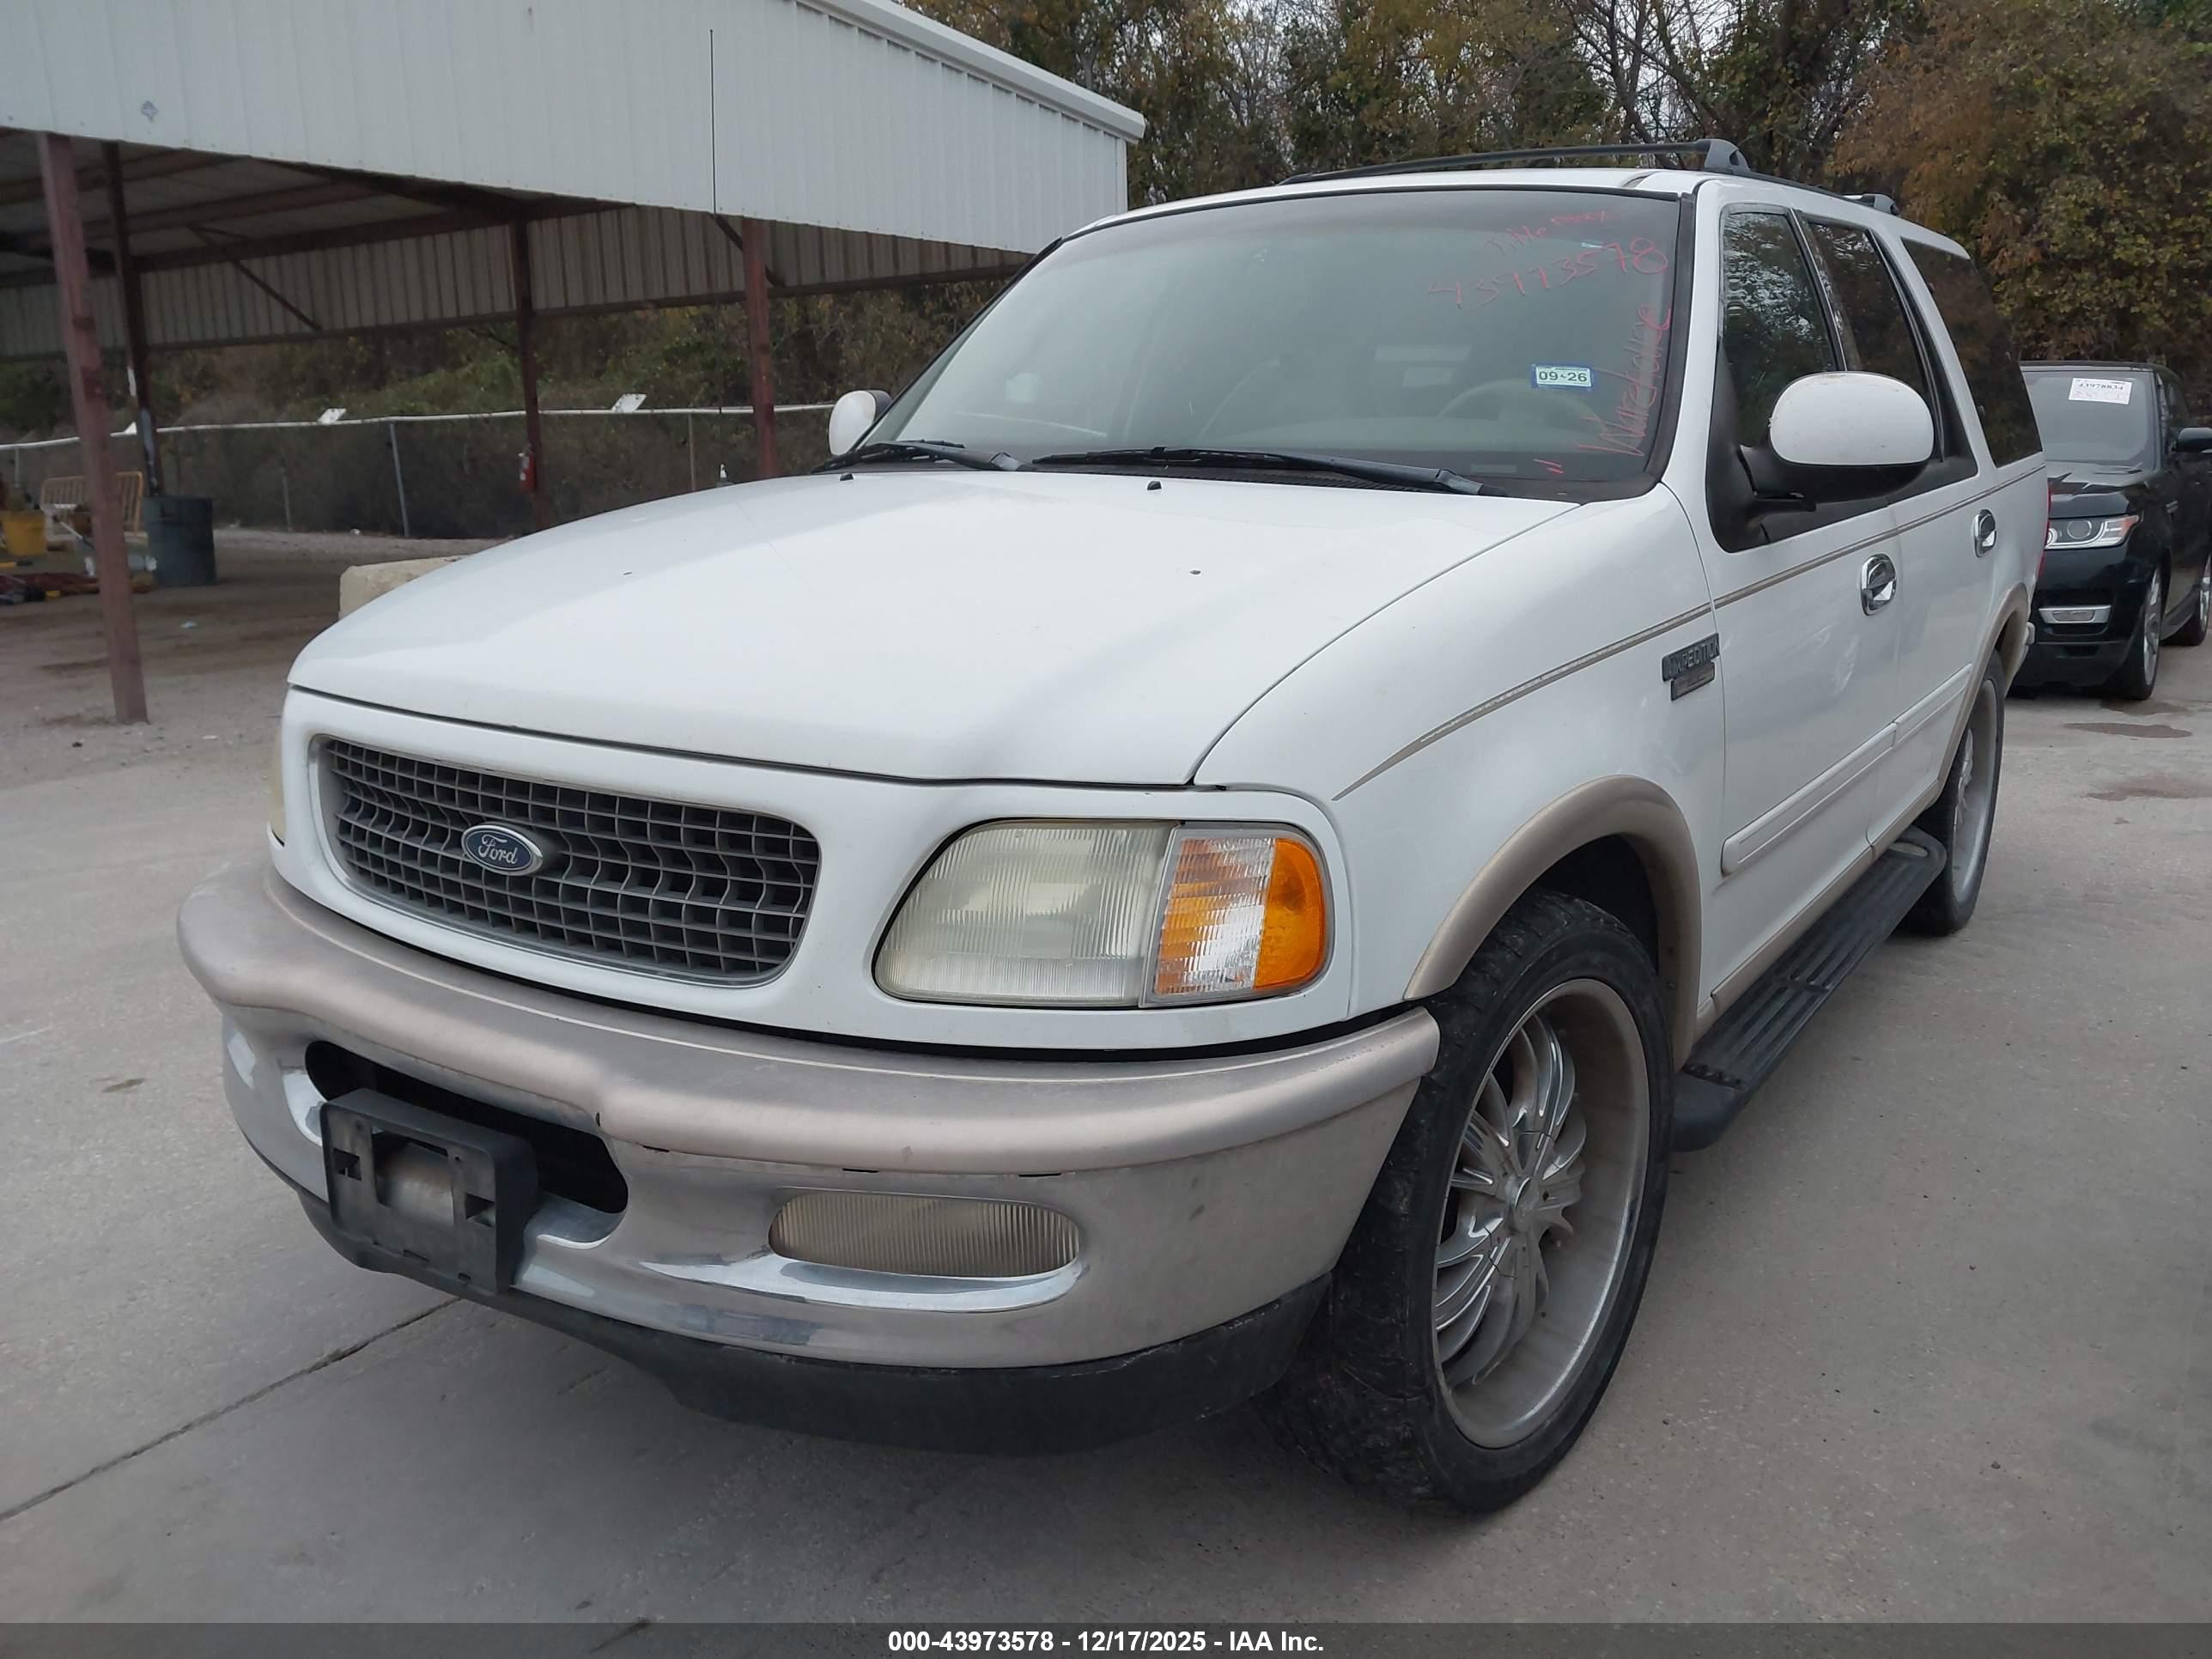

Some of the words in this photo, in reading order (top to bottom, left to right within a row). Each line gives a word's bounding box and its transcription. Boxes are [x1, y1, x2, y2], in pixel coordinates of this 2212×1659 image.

[1539, 371, 1559, 380] 09
[1567, 372, 1588, 382] 26
[478, 834, 519, 865] Ford
